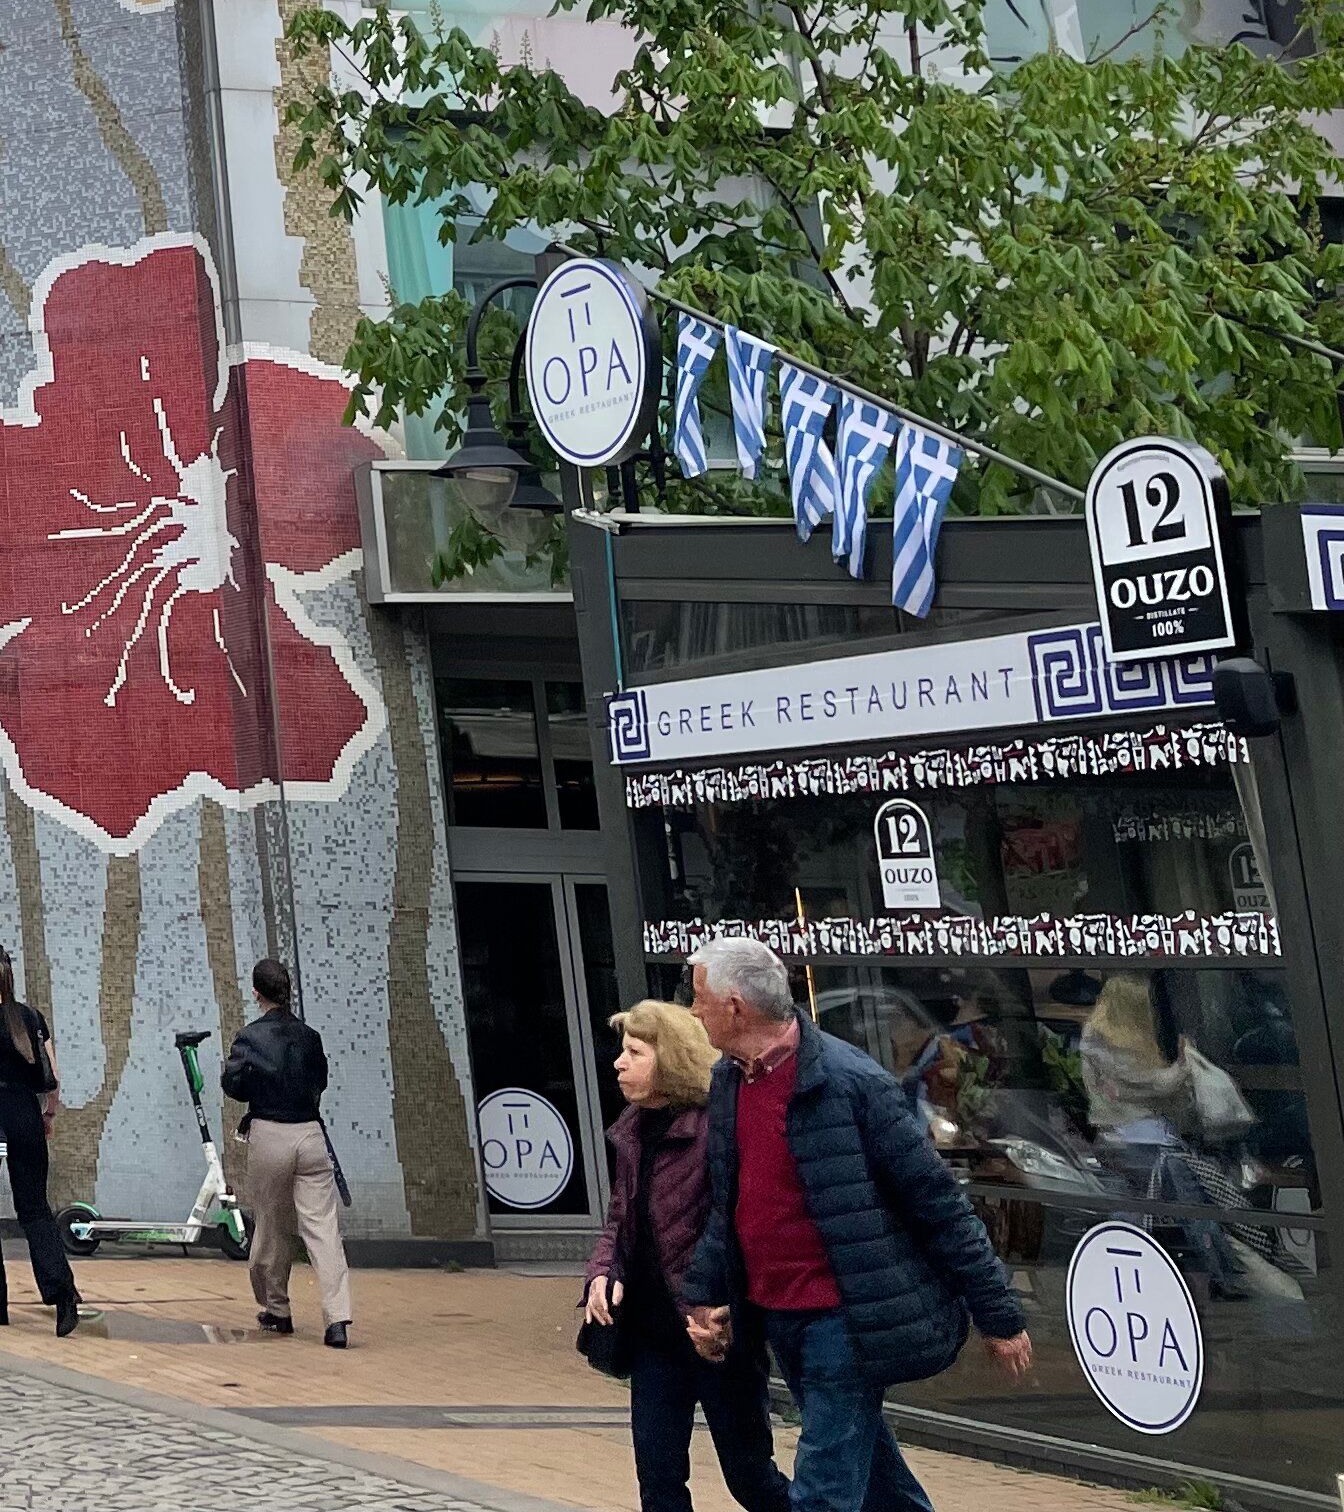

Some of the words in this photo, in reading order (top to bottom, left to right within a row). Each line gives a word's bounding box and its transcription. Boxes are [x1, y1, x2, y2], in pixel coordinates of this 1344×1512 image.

[543, 337, 633, 405] OPA
[548, 408, 576, 424] GREEK
[579, 391, 635, 414] RESTAURANT
[1116, 471, 1187, 548] 12
[1110, 564, 1214, 610] OUZO
[1152, 619, 1185, 638] 100%
[657, 700, 756, 737] GREEK
[776, 667, 1014, 725] RESTAURANT
[885, 814, 921, 854] 12
[885, 867, 933, 885] OUZO
[1237, 894, 1271, 908] OUZ
[482, 1139, 563, 1169] OPA
[1085, 1307, 1190, 1373] OPA
[1092, 1363, 1123, 1376] GREEK
[1127, 1369, 1192, 1388] RESTAURANT
